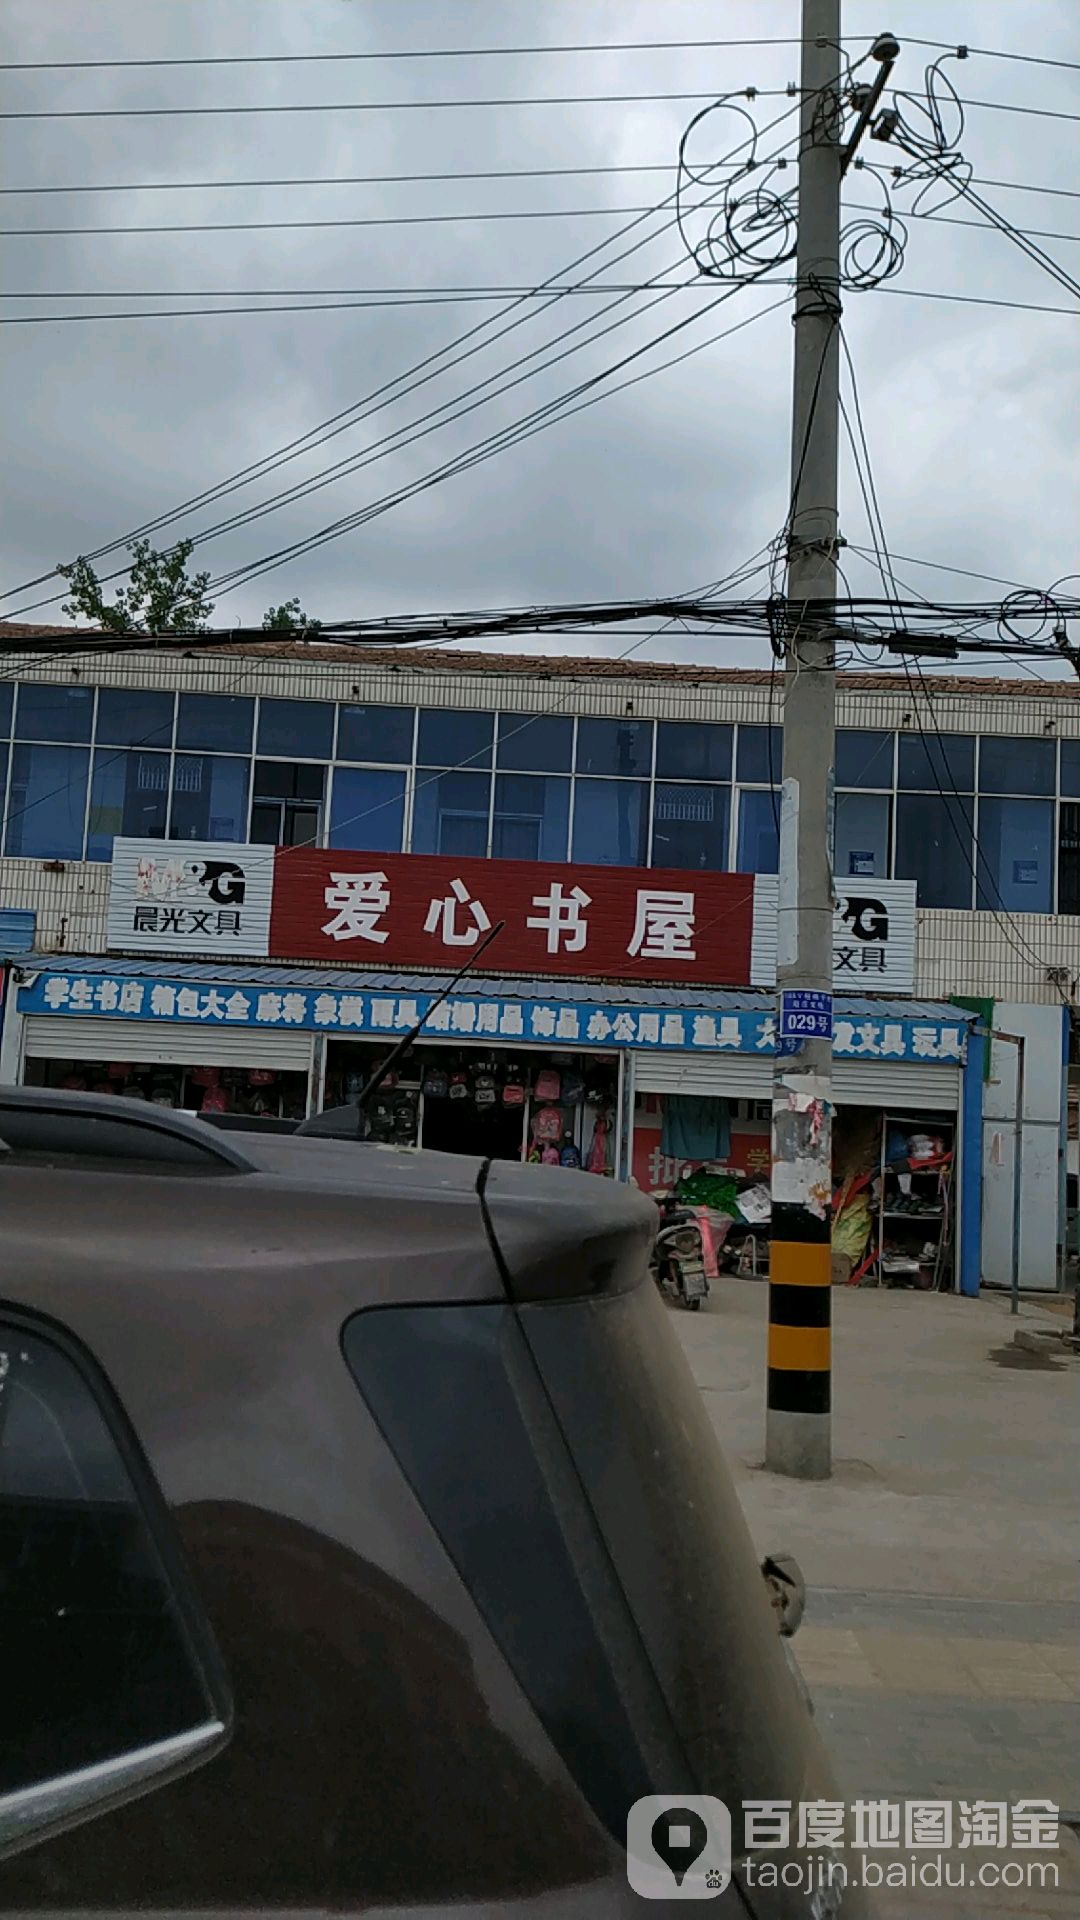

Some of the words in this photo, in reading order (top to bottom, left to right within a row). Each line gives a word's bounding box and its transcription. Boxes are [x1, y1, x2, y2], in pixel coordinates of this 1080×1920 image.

[133, 906, 242, 936] 晨光文具
[320, 871, 697, 960] 爱心书屋
[44, 977, 145, 1014] 学生书店
[150, 984, 251, 1020] 箱包大全
[587, 1010, 685, 1045] 办公用品
[788, 1014, 829, 1033] 029号
